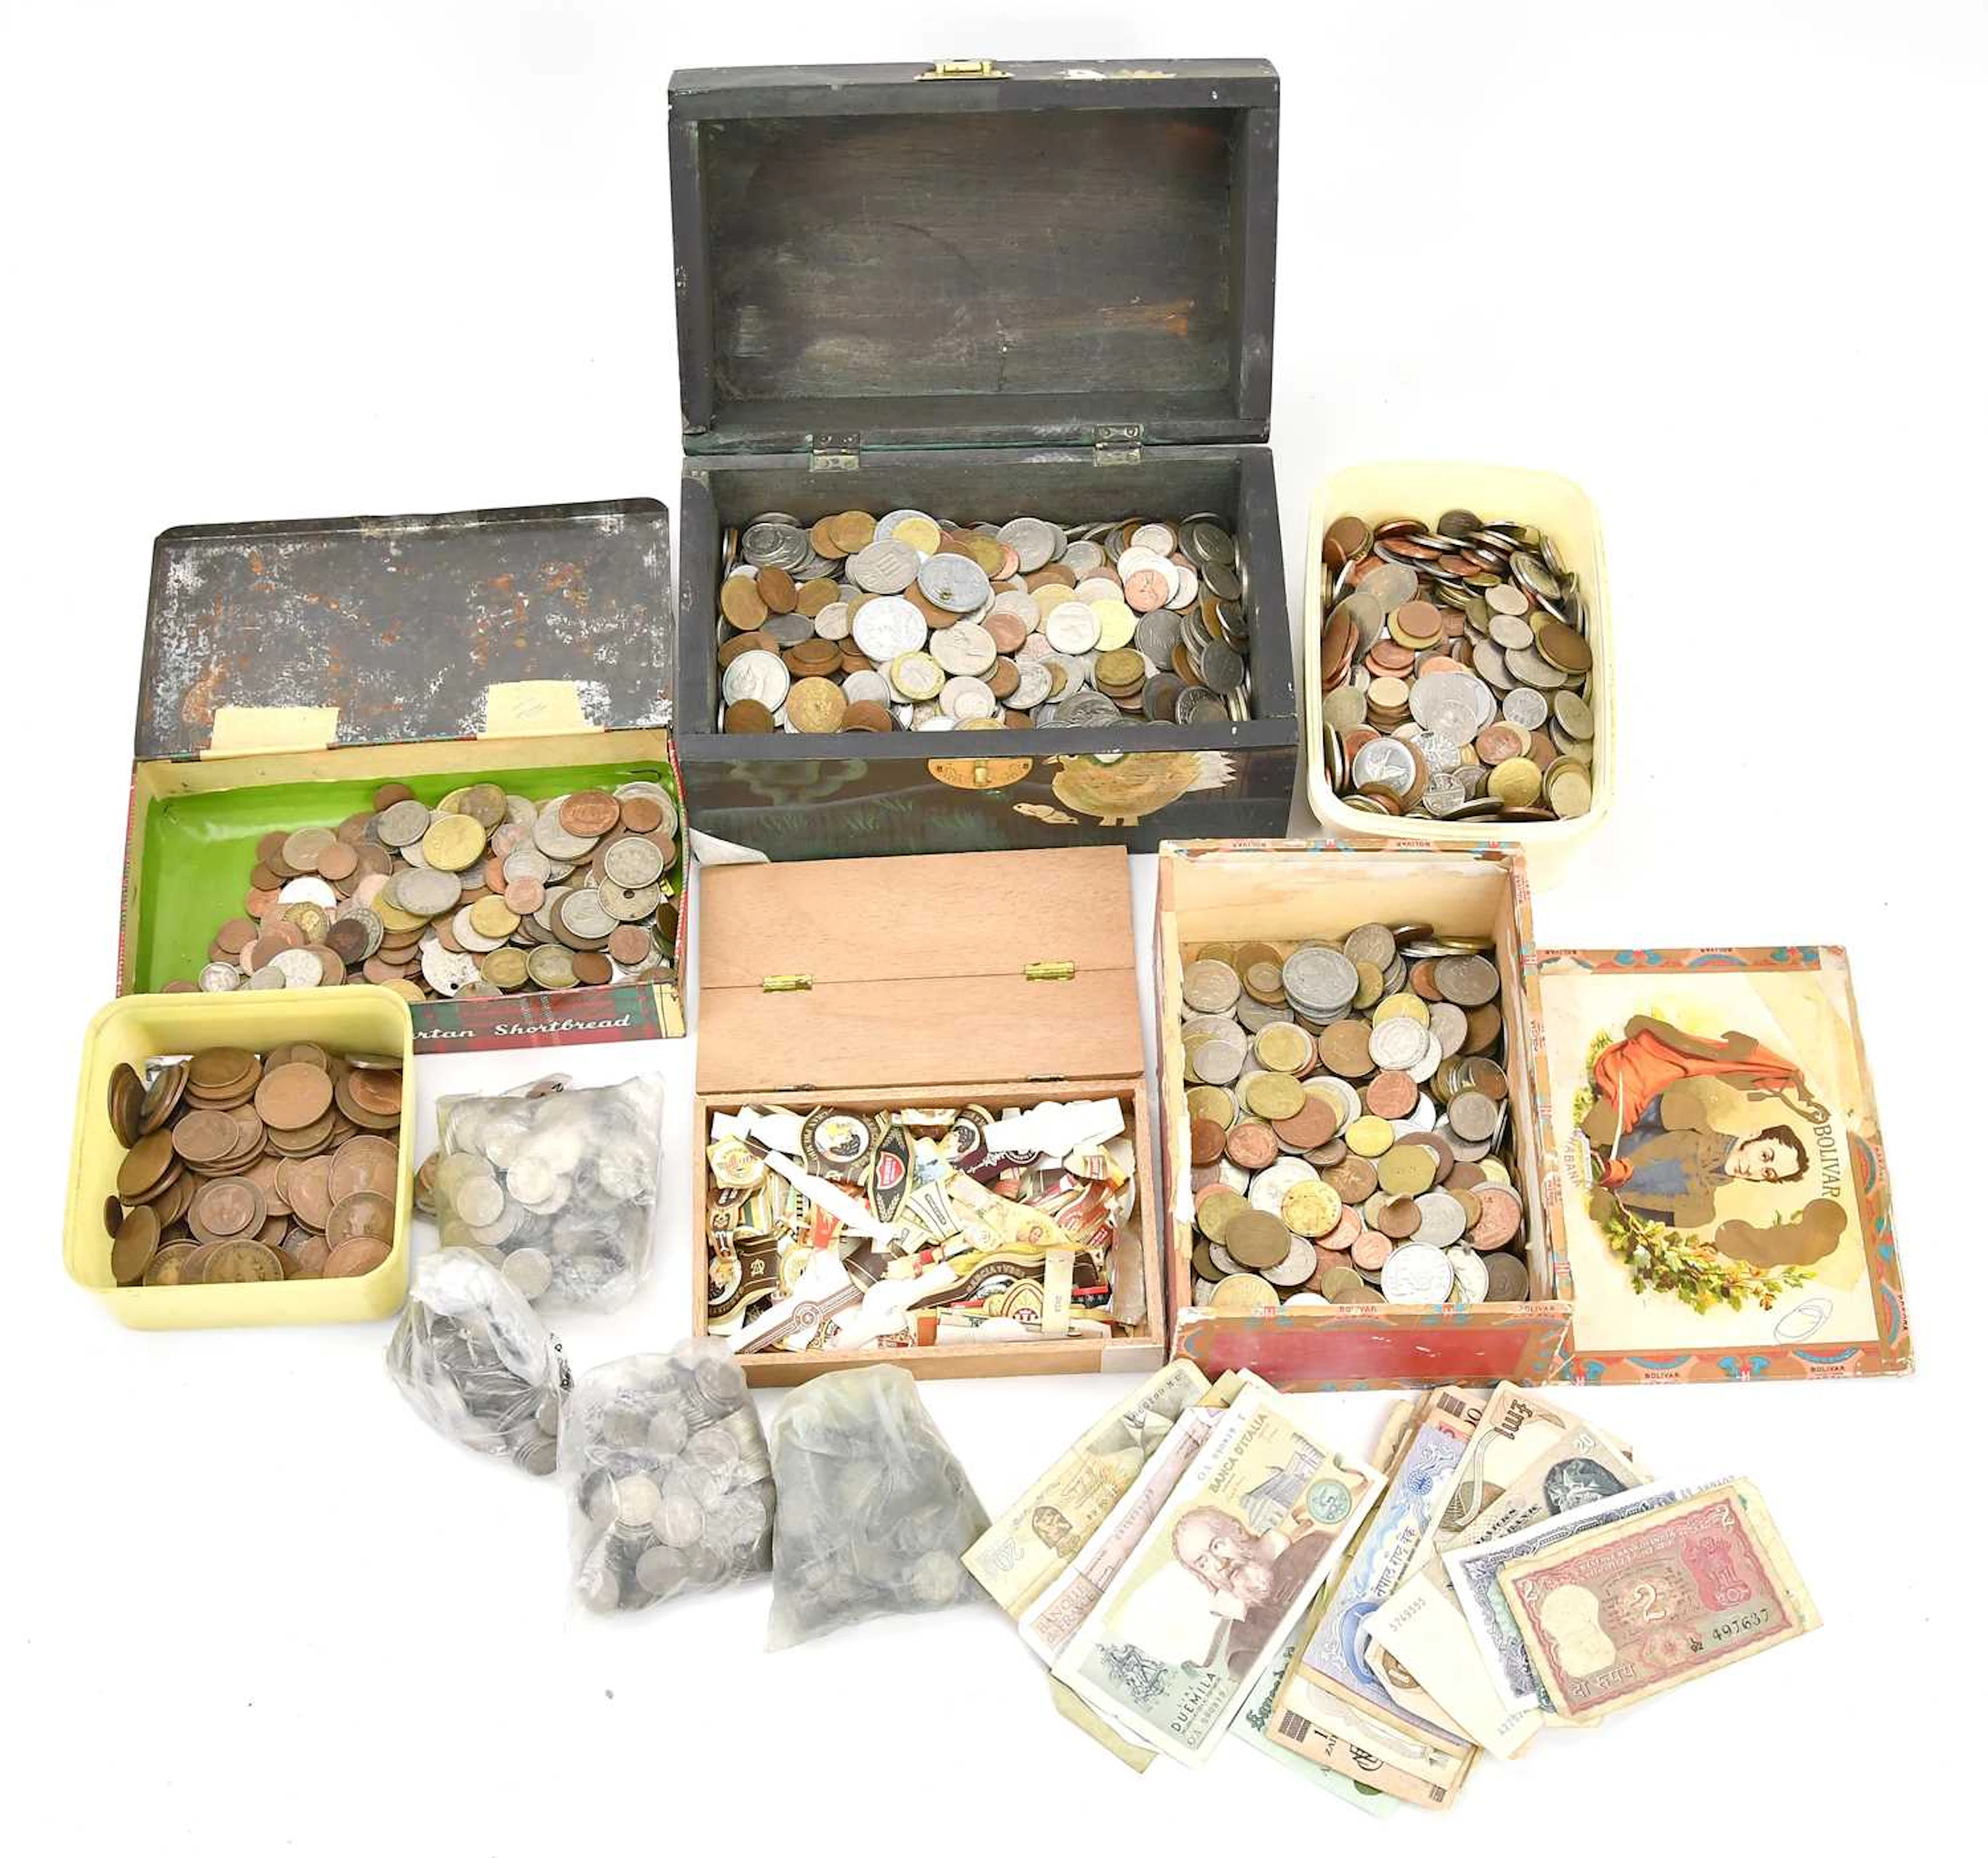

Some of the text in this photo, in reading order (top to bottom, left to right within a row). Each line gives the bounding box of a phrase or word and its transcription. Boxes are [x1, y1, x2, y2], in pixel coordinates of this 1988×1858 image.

[414, 1014, 632, 1040] rtan Shortbread
[1814, 1122, 1840, 1198] BOLIVAR
[1208, 1413, 1268, 1494] BANCA D'ITALIA
[1717, 1504, 1736, 1527] 2
[1518, 1578, 1539, 1604] 2
[1632, 1582, 1667, 1622] 2
[1711, 1608, 1771, 1642] 497637
[1170, 1673, 1216, 1732] DUEMILA
